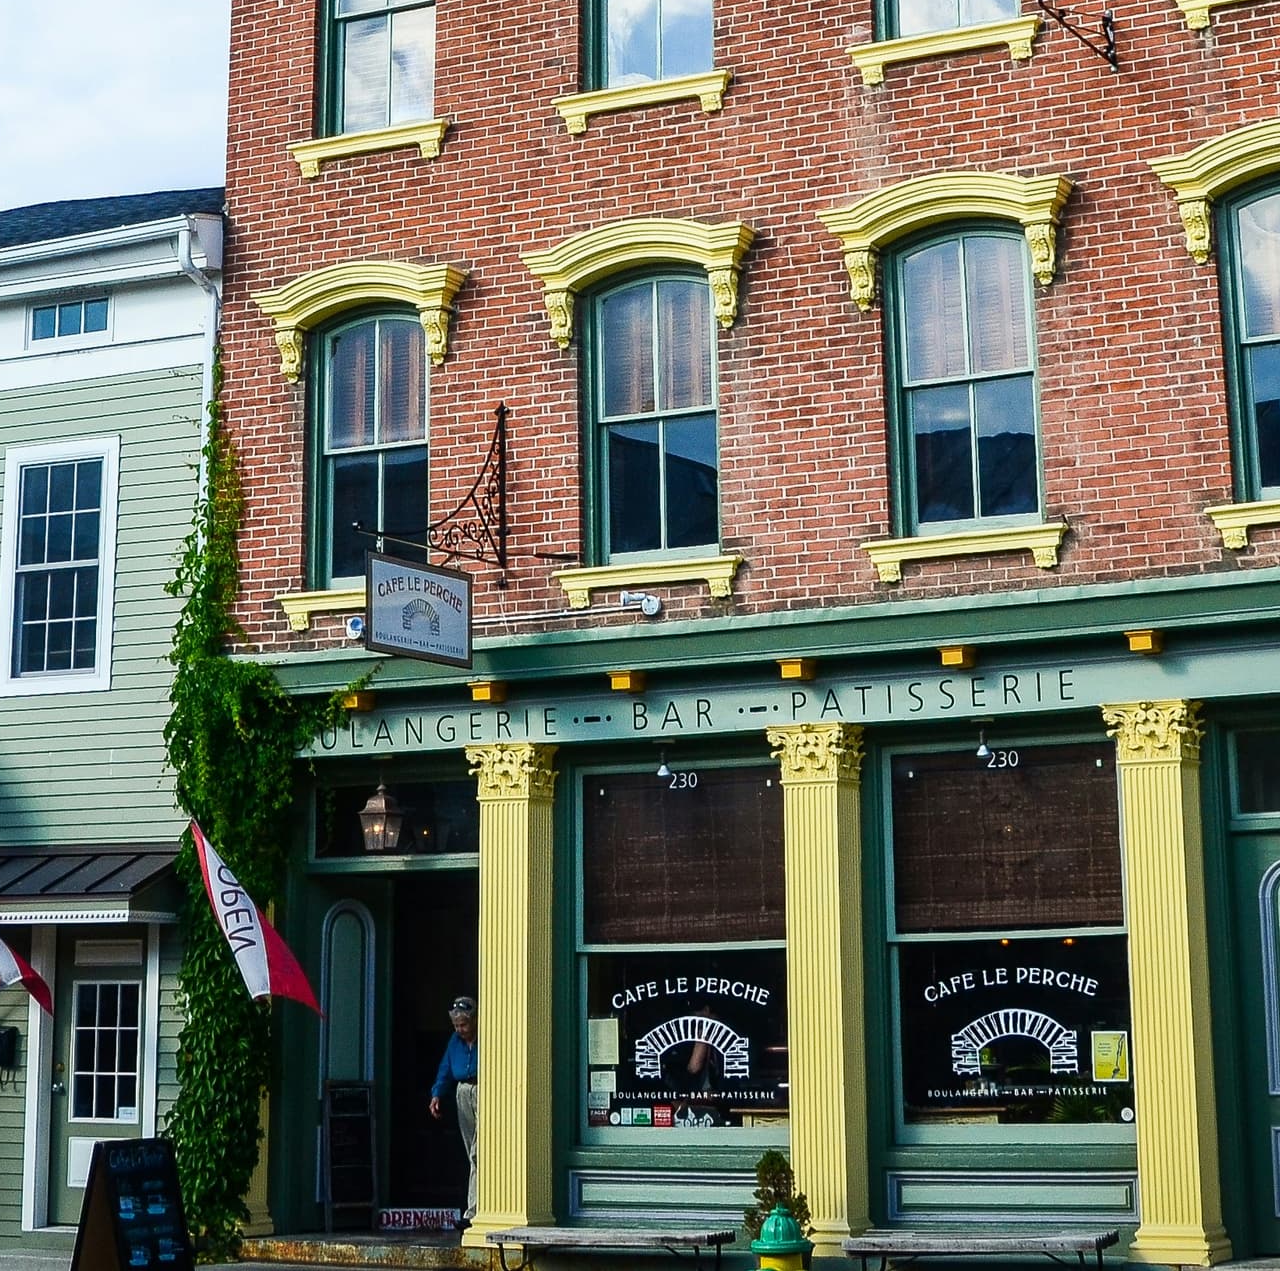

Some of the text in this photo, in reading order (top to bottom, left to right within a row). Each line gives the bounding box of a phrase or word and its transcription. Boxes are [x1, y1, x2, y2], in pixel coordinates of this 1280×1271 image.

[377, 576, 463, 614] CAFE LE PERCHE
[375, 631, 413, 645] BOULANGERIE
[419, 640, 429, 648] BAR
[291, 668, 1076, 752] ULANGERIE BAR PATISSERIE
[987, 750, 1019, 768] 230
[669, 772, 698, 789] 230
[612, 977, 771, 1010] CAFE LE PERCHE
[924, 967, 1100, 1003] CAFE LE PERCHE
[690, 1091, 709, 1100] BAR
[721, 1091, 775, 1100] PATISSERIE
[927, 1086, 1108, 1098] BOULANGERIE BAR PATISSERIE
[378, 1210, 423, 1227] OPEN
